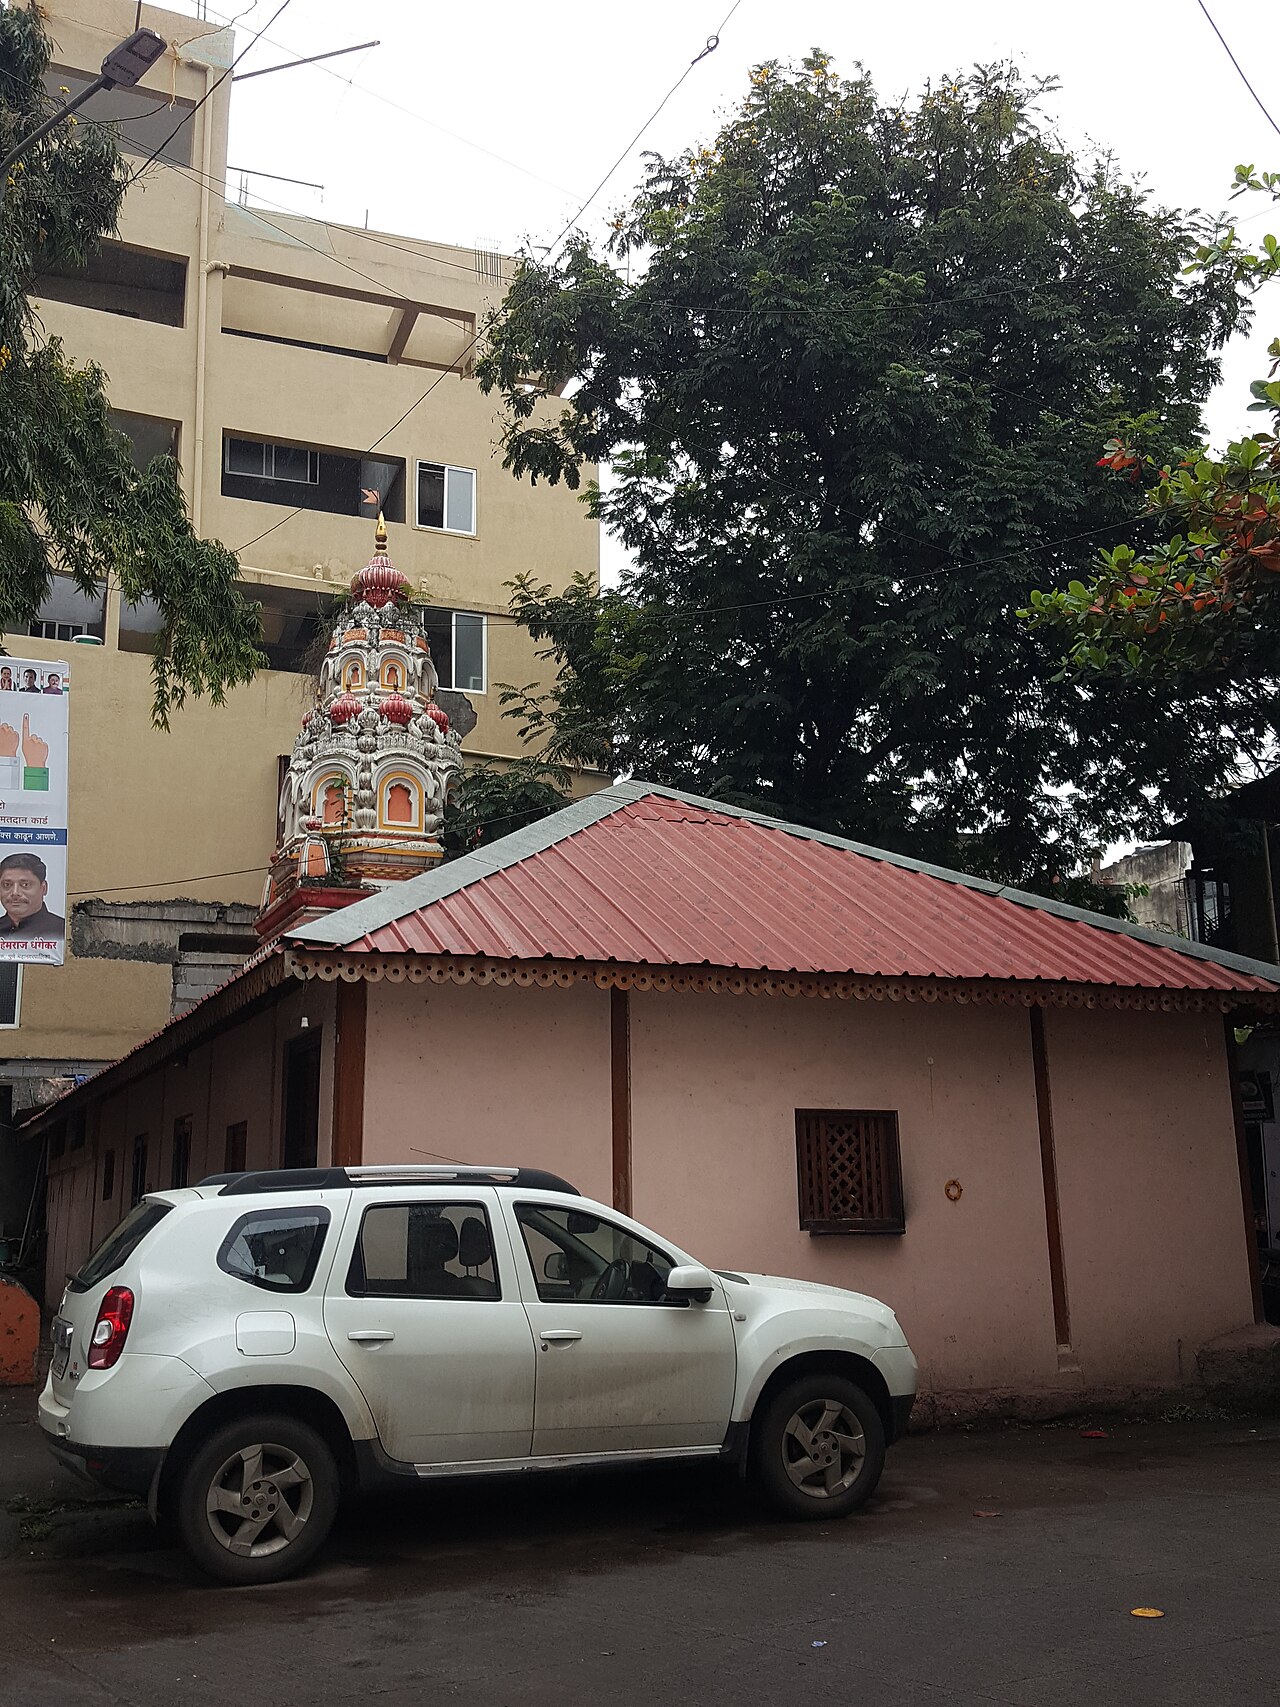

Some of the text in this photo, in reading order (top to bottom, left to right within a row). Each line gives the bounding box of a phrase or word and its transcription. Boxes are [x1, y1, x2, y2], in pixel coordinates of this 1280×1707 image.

[31, 815, 48, 824] कार्ड
[0, 937, 57, 950] हेमराज धंगेकर
